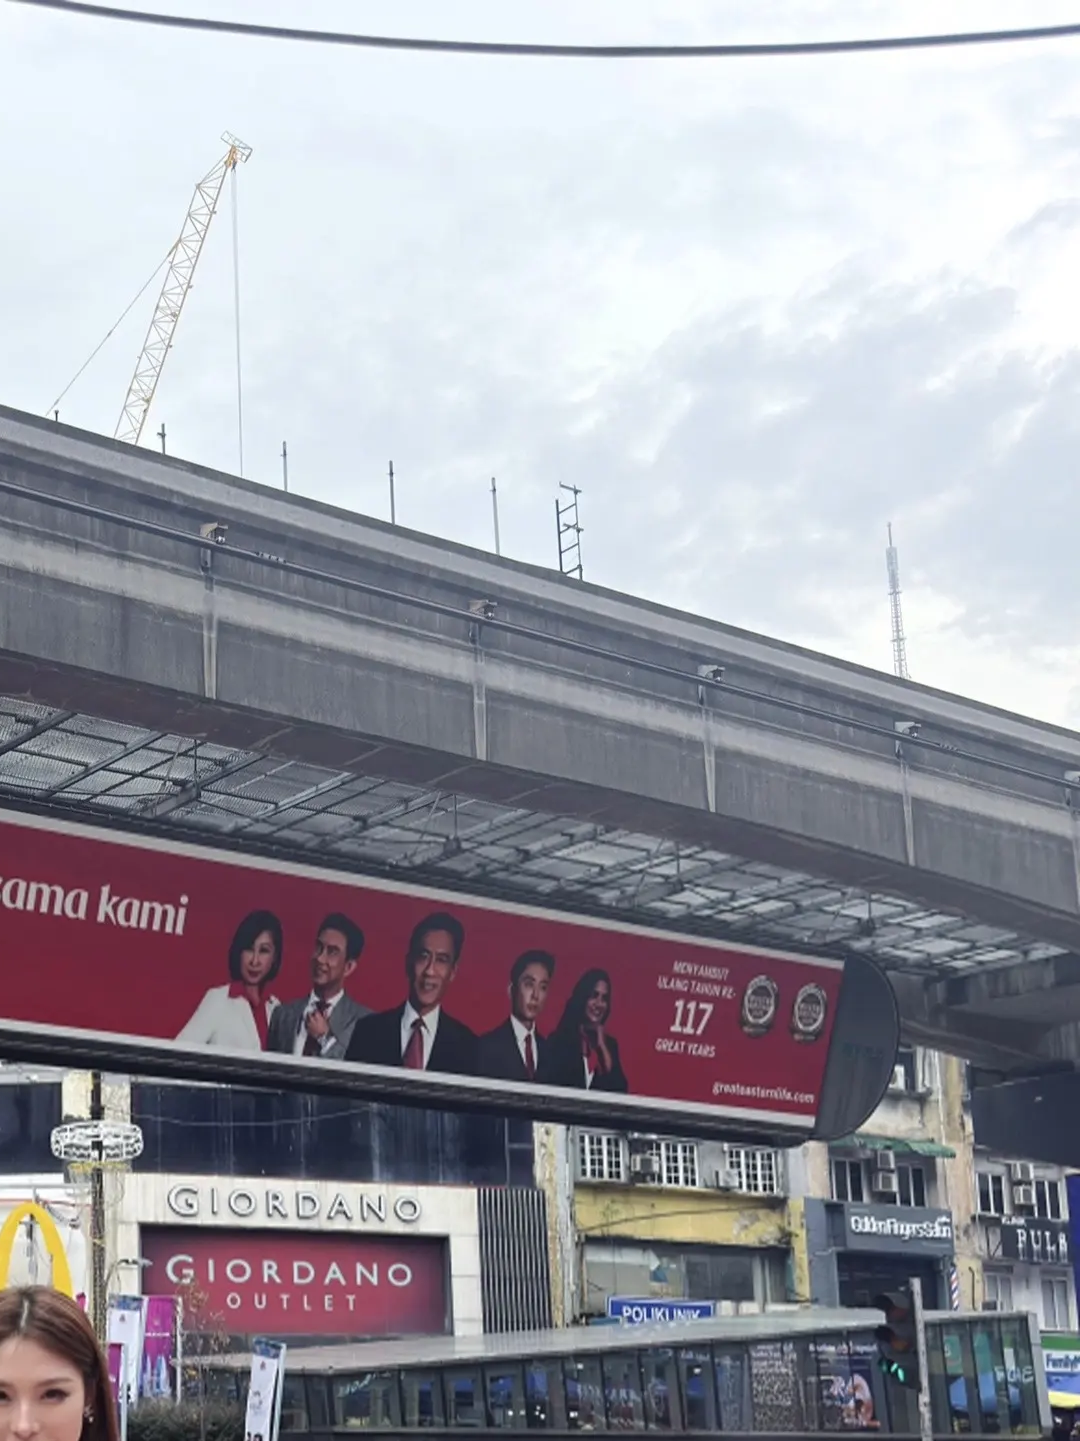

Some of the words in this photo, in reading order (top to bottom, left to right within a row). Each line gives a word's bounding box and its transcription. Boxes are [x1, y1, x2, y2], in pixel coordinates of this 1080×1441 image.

[96, 883, 189, 936] kami
[670, 998, 715, 1036] 117
[655, 1038, 686, 1053] GREAT
[687, 1042, 716, 1058] YEARS
[167, 1183, 422, 1223] GIORDANO
[165, 1253, 413, 1287] GIORDANO
[226, 1291, 358, 1313] OUTLET
